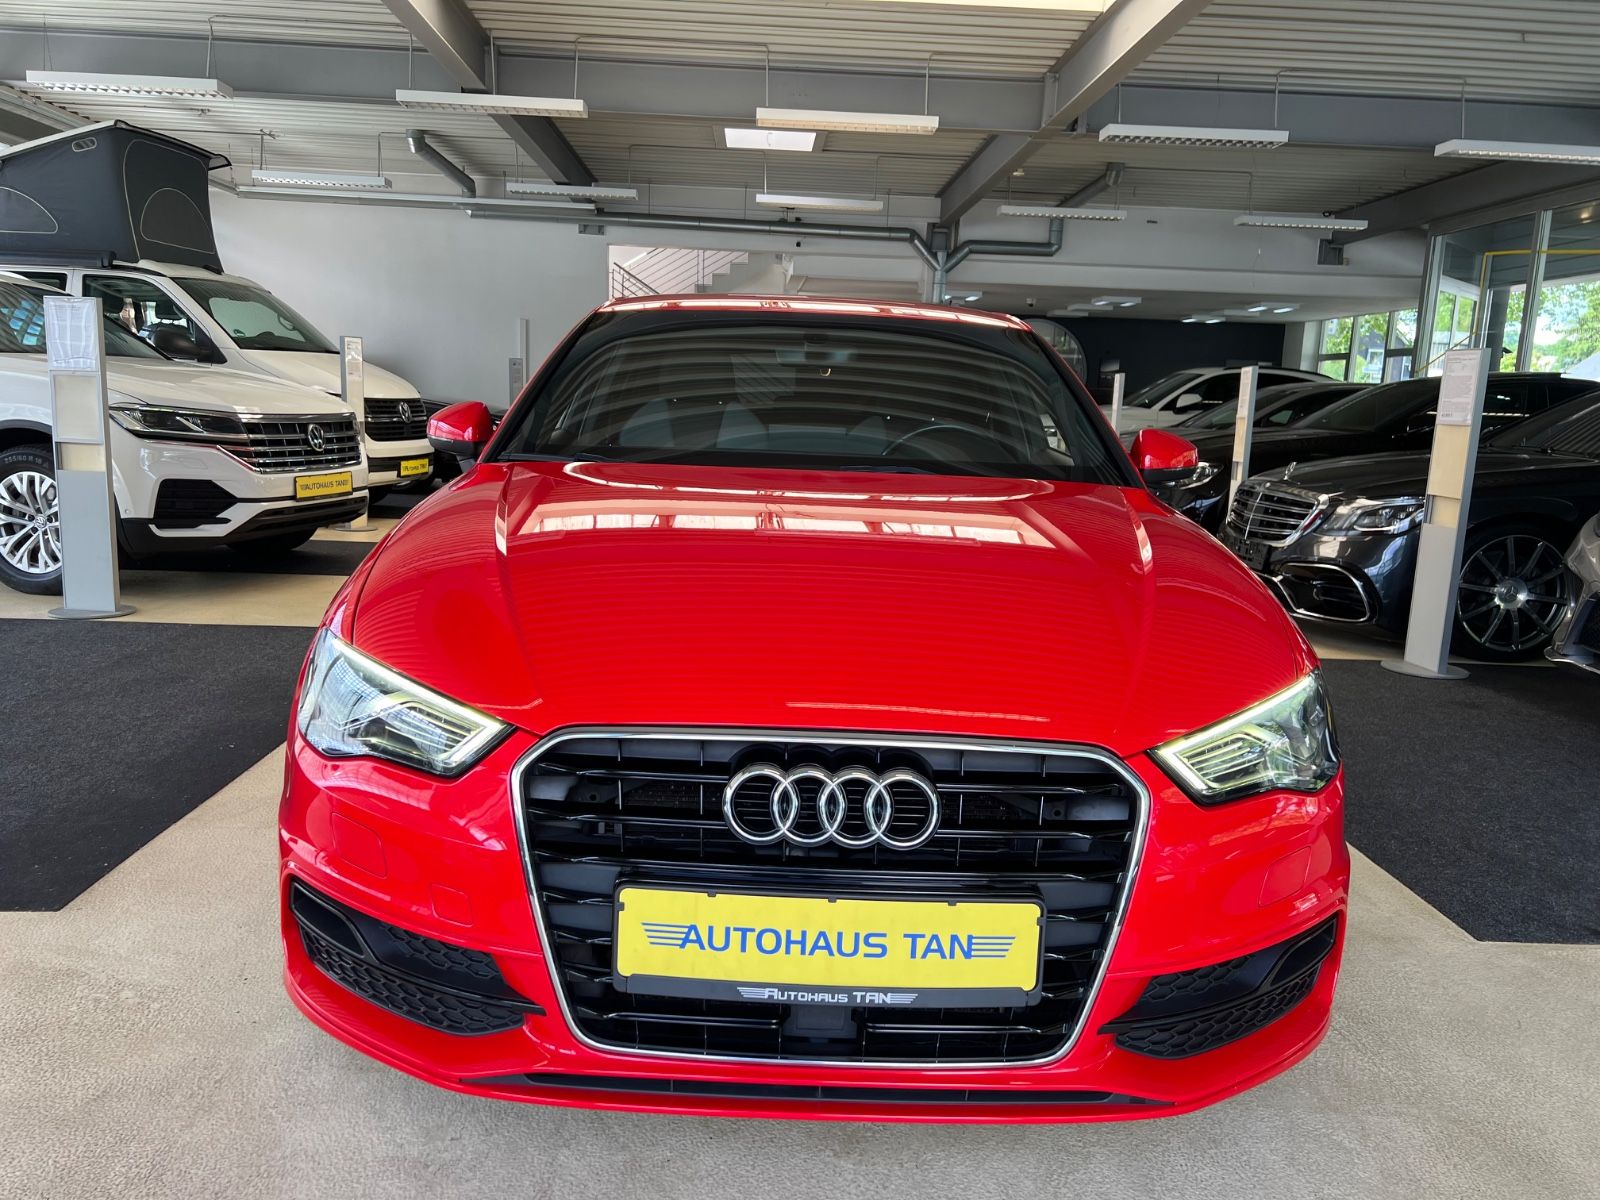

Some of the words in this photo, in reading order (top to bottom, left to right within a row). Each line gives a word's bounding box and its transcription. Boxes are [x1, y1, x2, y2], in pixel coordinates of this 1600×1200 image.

[305, 481, 334, 490] AUTOHAUS
[680, 925, 888, 959] AUTOHAUS
[904, 934, 974, 960] TAN
[764, 988, 848, 1003] AUTOHAUS
[852, 991, 891, 1004] TAN
